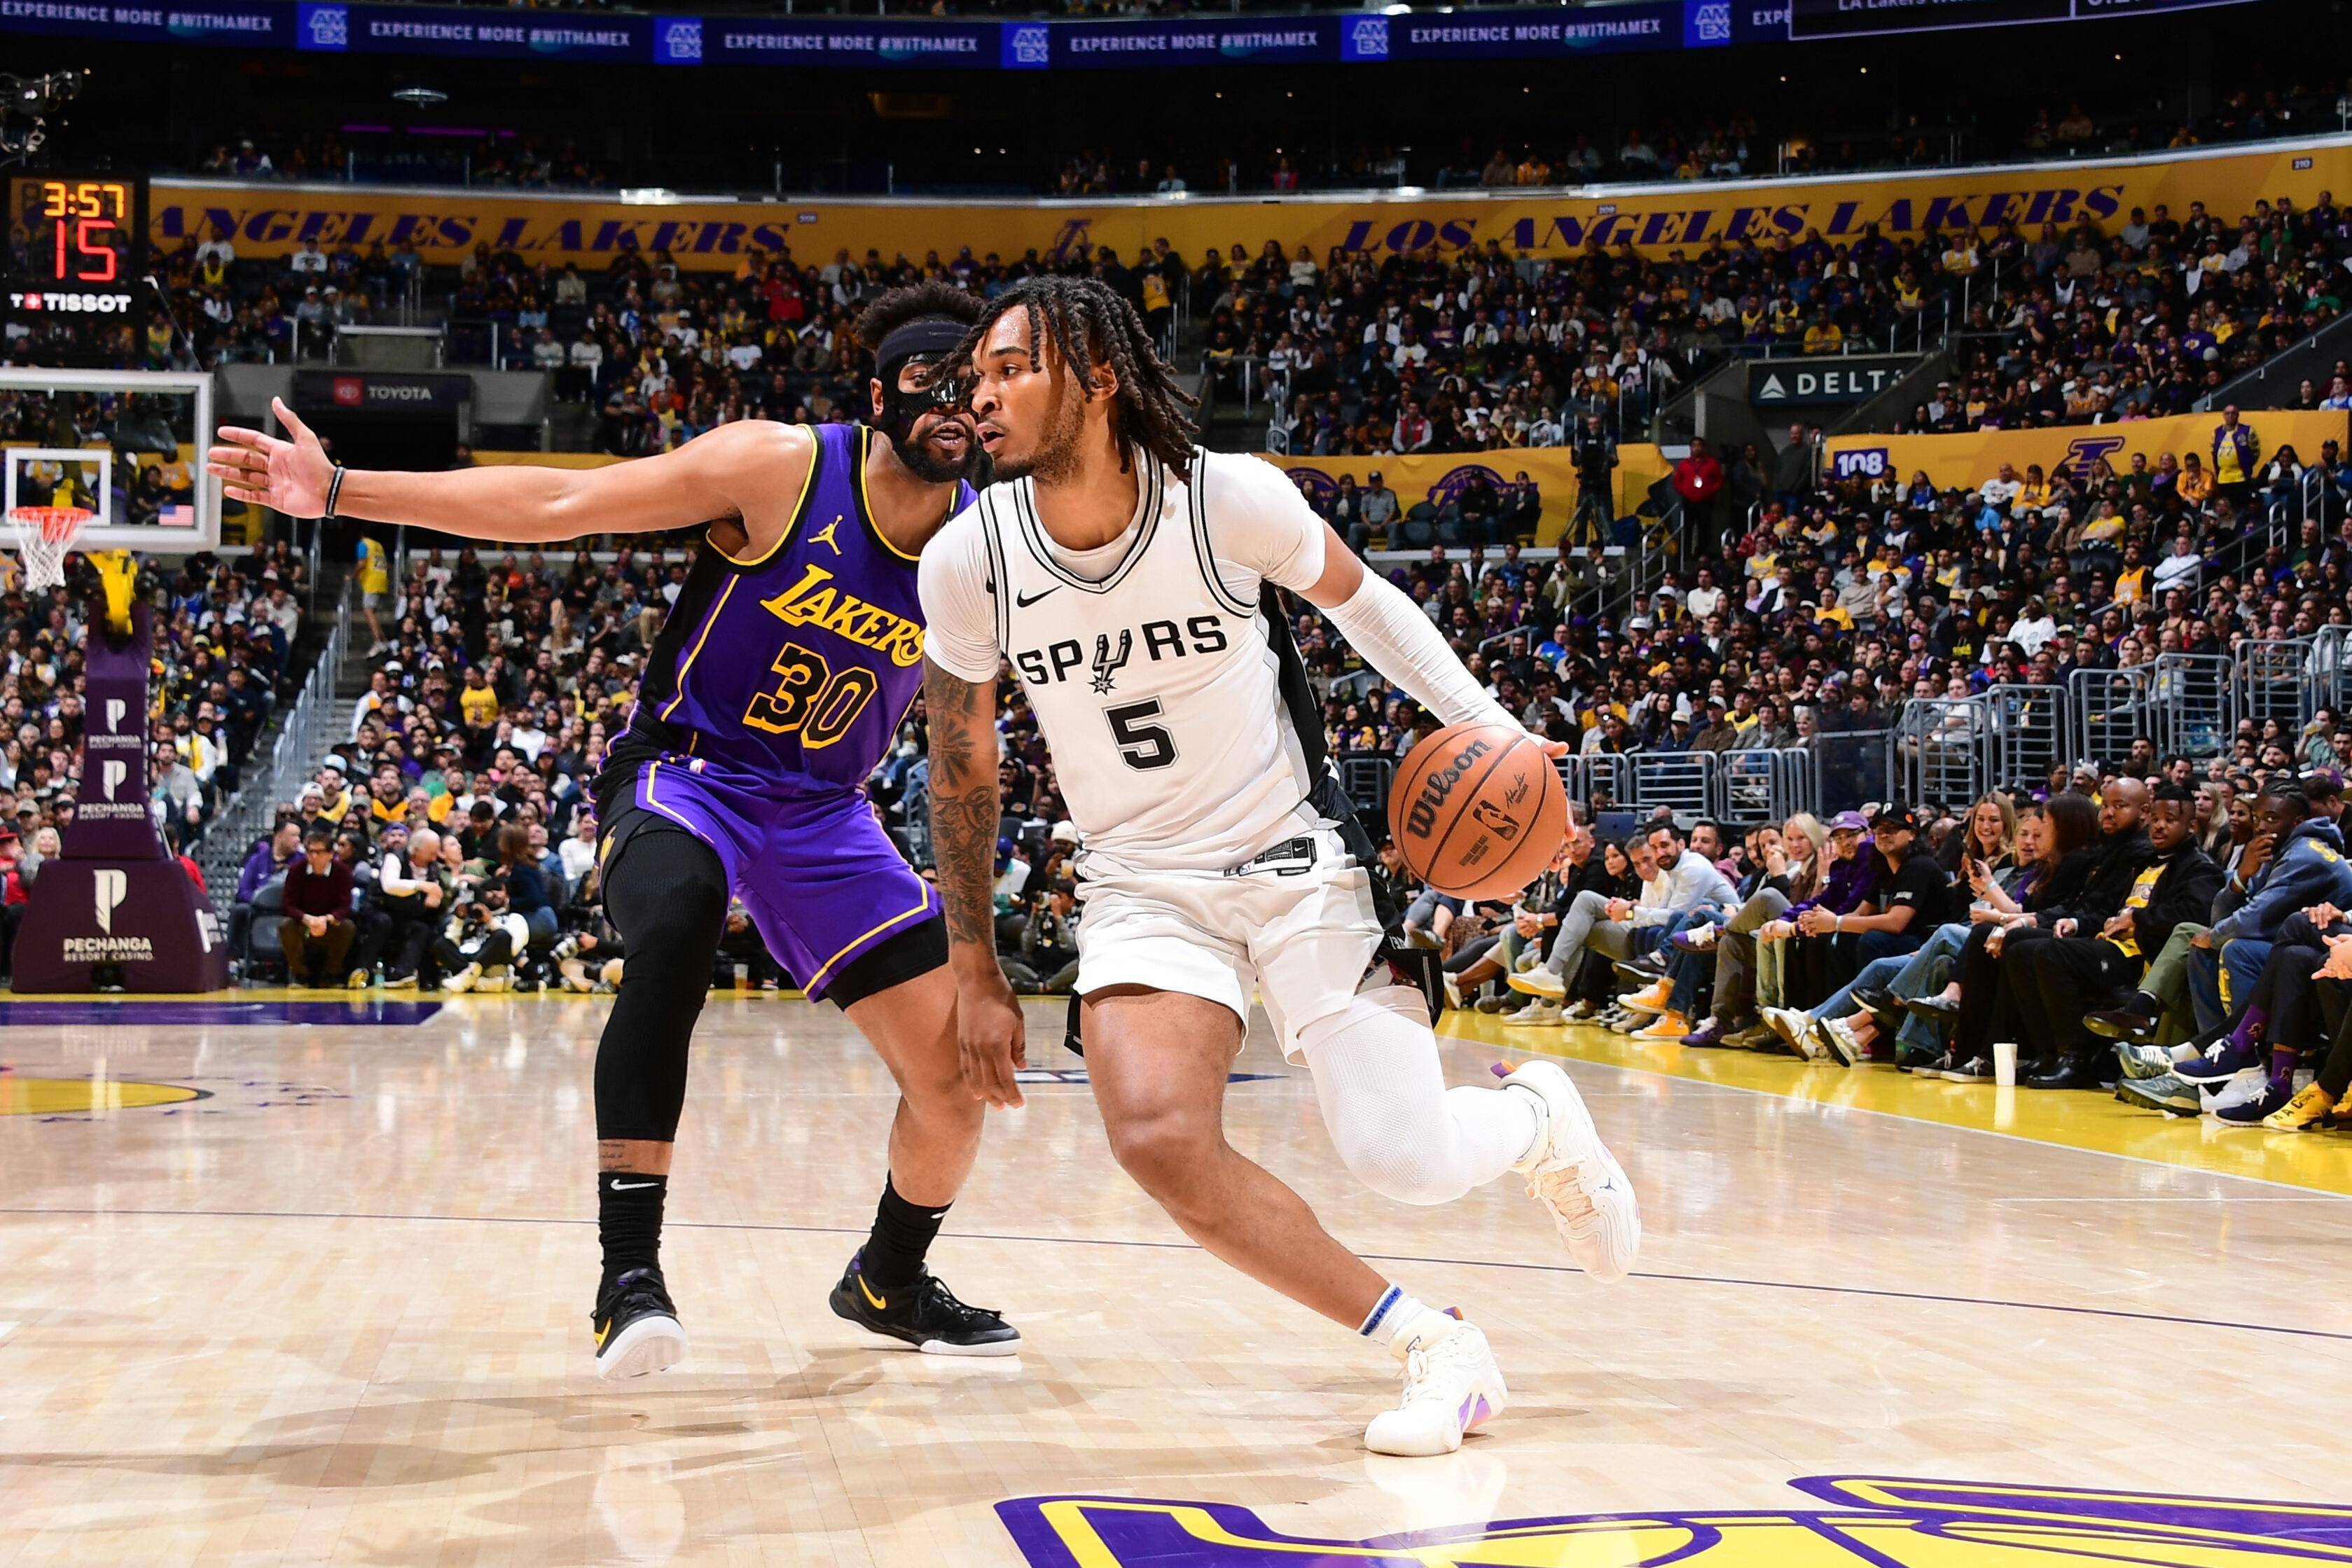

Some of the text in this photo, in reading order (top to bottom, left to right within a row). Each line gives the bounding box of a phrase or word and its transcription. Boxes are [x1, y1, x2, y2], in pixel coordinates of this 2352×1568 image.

[1, 2, 272, 31] EXPERIENCE MORE #WITHAMEX
[371, 22, 630, 46] EXPERIENCE MORE #WITHAMEX
[725, 34, 977, 52] EXPERIENCE MORE #WITHAMEX
[1070, 32, 1317, 52] EXPERIENCE MORE #WITHAMEX
[1411, 20, 1660, 43] EXPERIENCE MORE #WITHAMEX
[43, 182, 125, 218] 3:57
[150, 206, 790, 254] ANGELES LAKERS
[1343, 185, 2124, 252] LOS ANGELES LAKERS
[56, 219, 116, 281] 15
[43, 293, 132, 312] TISSOT
[368, 385, 432, 400] TOYOTA
[1838, 452, 1883, 476] 108
[759, 563, 926, 667] LAKERS
[1016, 615, 1227, 695] SPURS
[742, 641, 878, 749] 30
[89, 735, 141, 744] PECHANGA
[1102, 695, 1180, 772] 5
[1407, 738, 1493, 839] Wilson
[78, 803, 144, 813] PECHANGA
[63, 937, 153, 952] PECHANGA
[64, 951, 154, 962] RESORT CASINO
